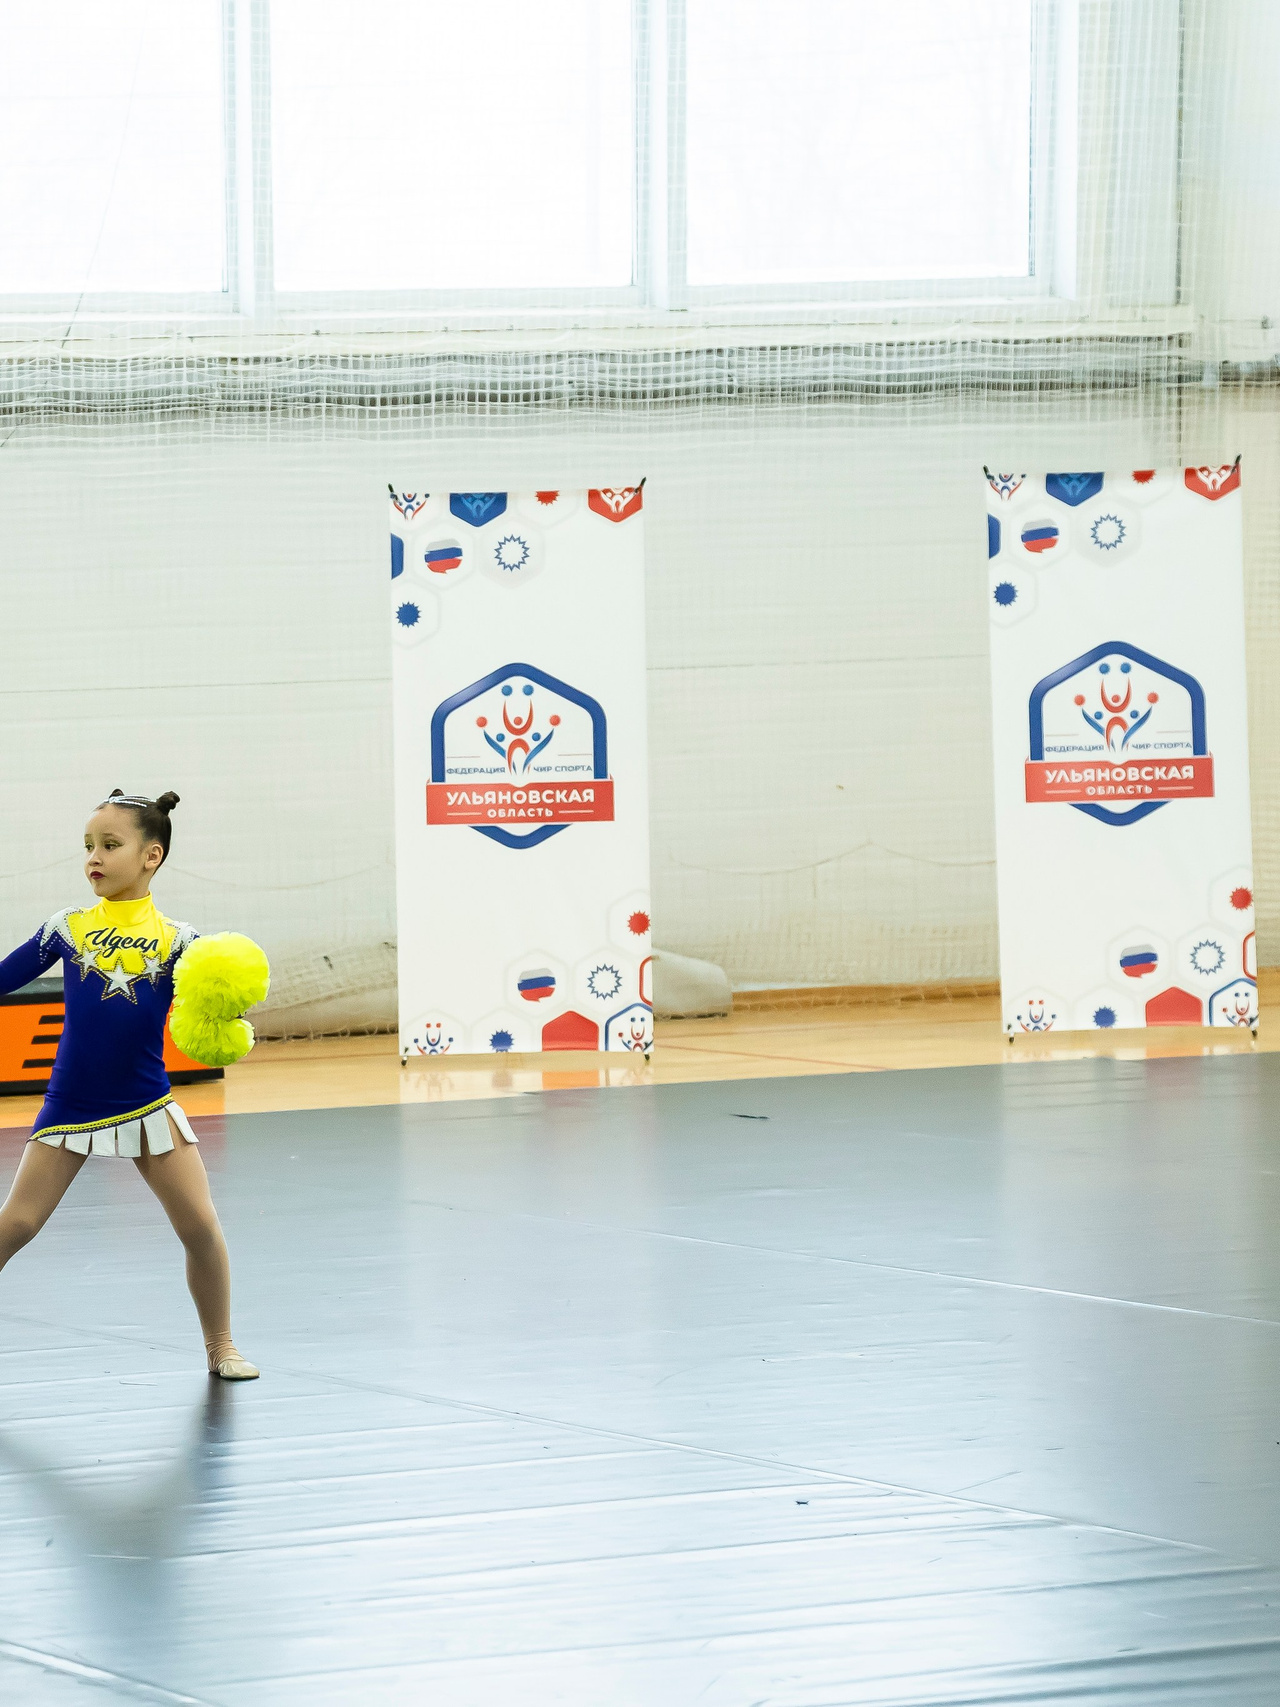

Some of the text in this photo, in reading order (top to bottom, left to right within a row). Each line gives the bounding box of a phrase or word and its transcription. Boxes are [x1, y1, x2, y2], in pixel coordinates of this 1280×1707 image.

[1045, 744, 1104, 753] ФЕДЕРАЦИЯ
[1153, 742, 1192, 750] СПОРТА
[446, 767, 506, 775] ФЕДЕРАЦИЯ
[555, 765, 593, 773] СПОРТА
[1045, 765, 1194, 784] УЛЬЯНОВСКАЯ
[1085, 784, 1153, 796] ОБЛАСТЬ
[446, 789, 595, 806] УЛЬЯНОВСКАЯ
[487, 807, 554, 818] ОБЛАСТЬ
[85, 928, 159, 958] Идеал
